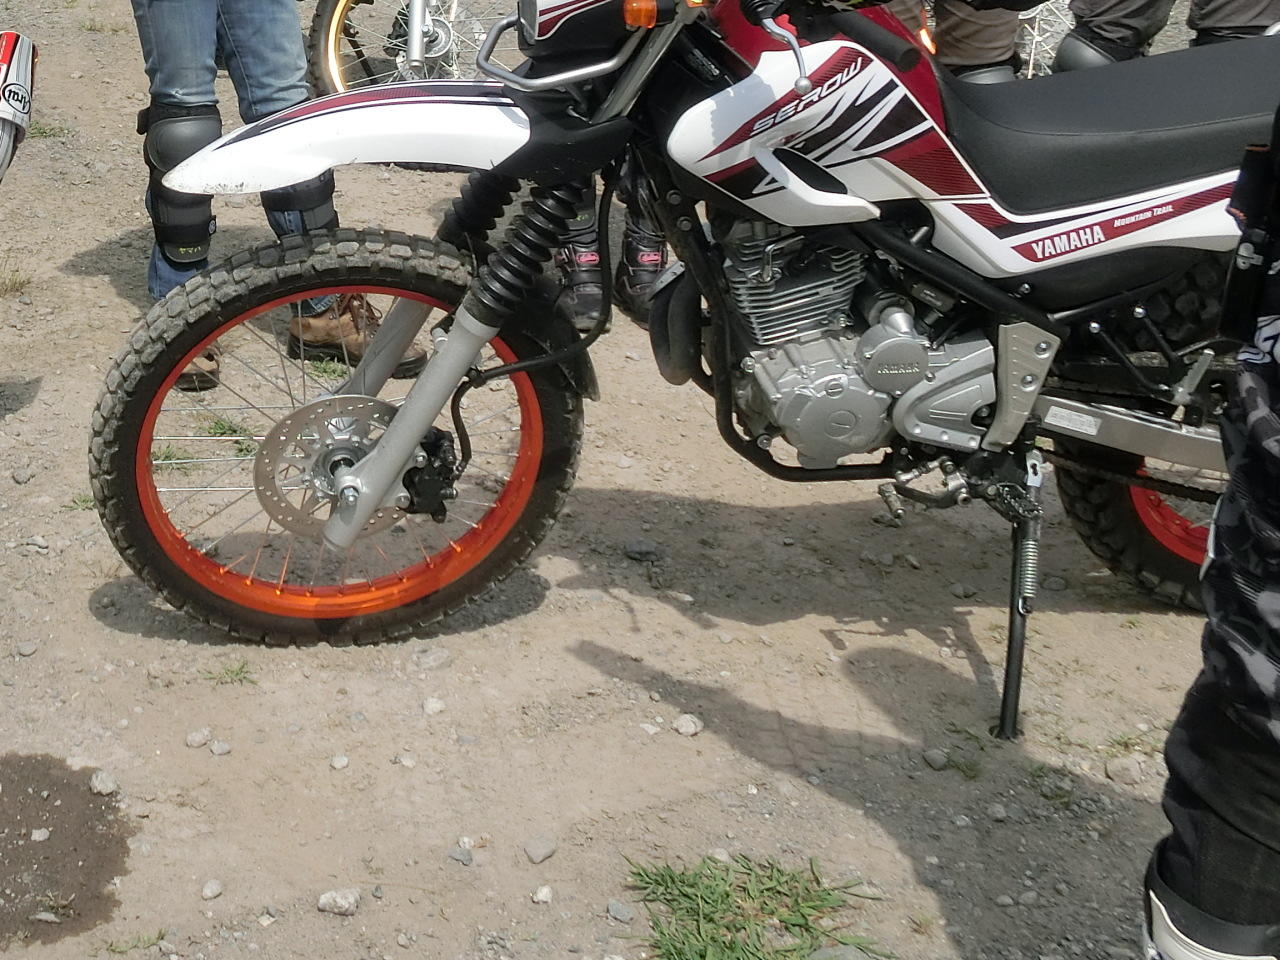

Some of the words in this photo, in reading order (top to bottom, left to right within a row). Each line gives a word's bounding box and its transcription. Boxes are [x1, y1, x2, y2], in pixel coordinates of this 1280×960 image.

[6, 88, 30, 111] Arai
[750, 57, 863, 137] SEROW
[1113, 211, 1153, 228] MOUNTAIN
[1152, 205, 1174, 218] TRAIL
[1031, 225, 1106, 259] YAMAHA
